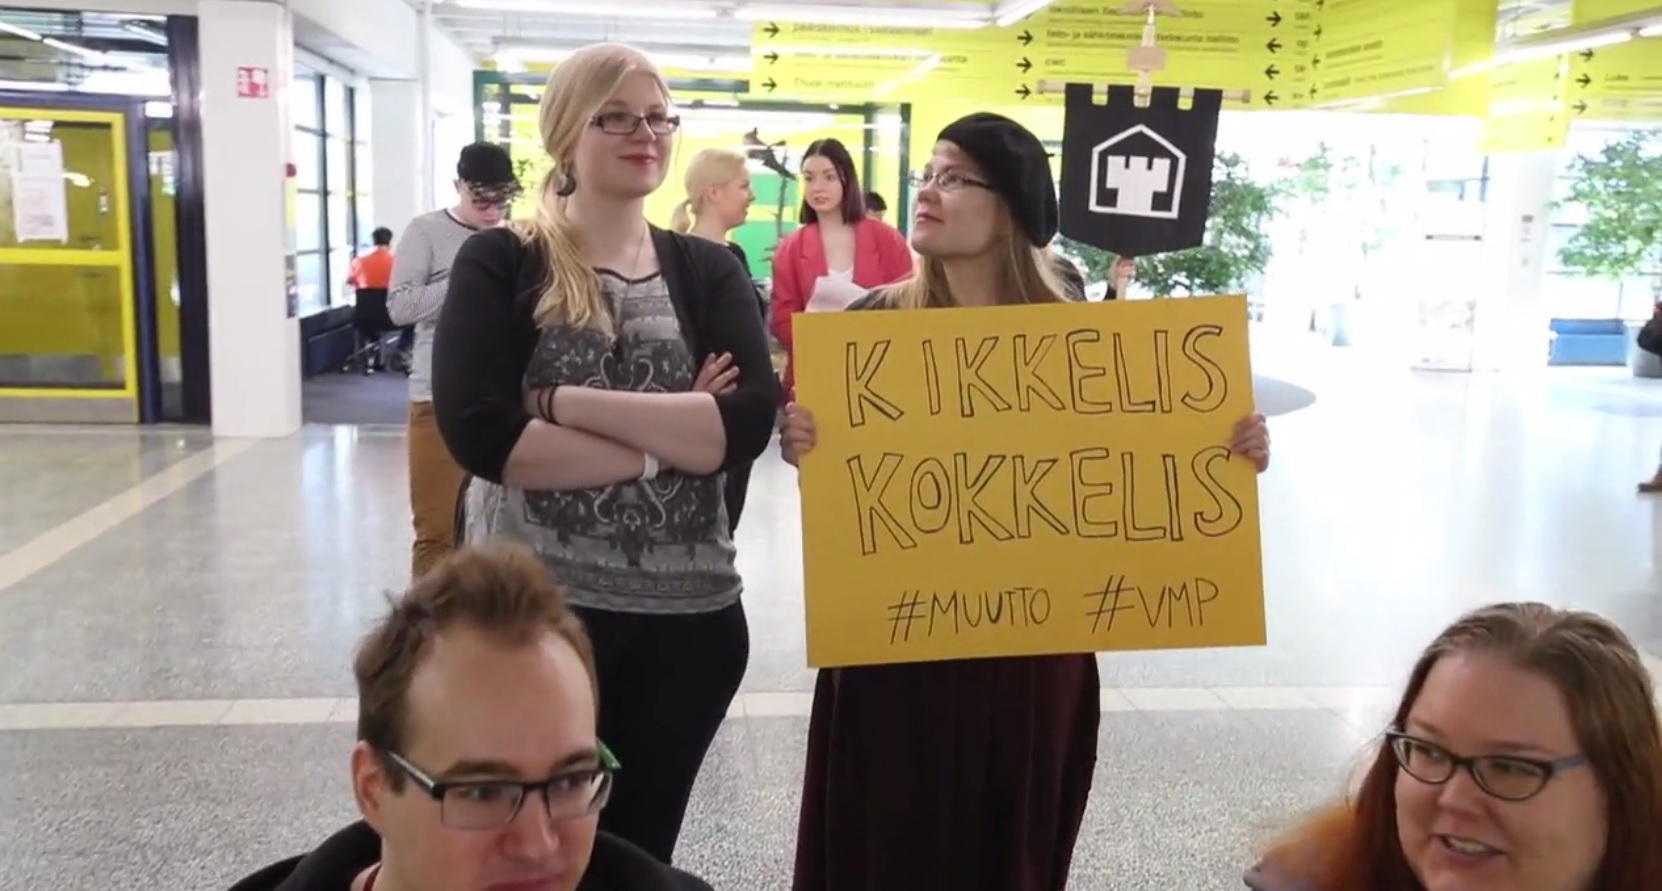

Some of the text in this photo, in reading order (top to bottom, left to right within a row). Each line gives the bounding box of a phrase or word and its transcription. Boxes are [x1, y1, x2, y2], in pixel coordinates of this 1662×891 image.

[845, 324, 1228, 427] KIKKELIS
[846, 445, 1243, 556] KOKKELIS
[887, 574, 1219, 645] #MUUTTO #VMP
